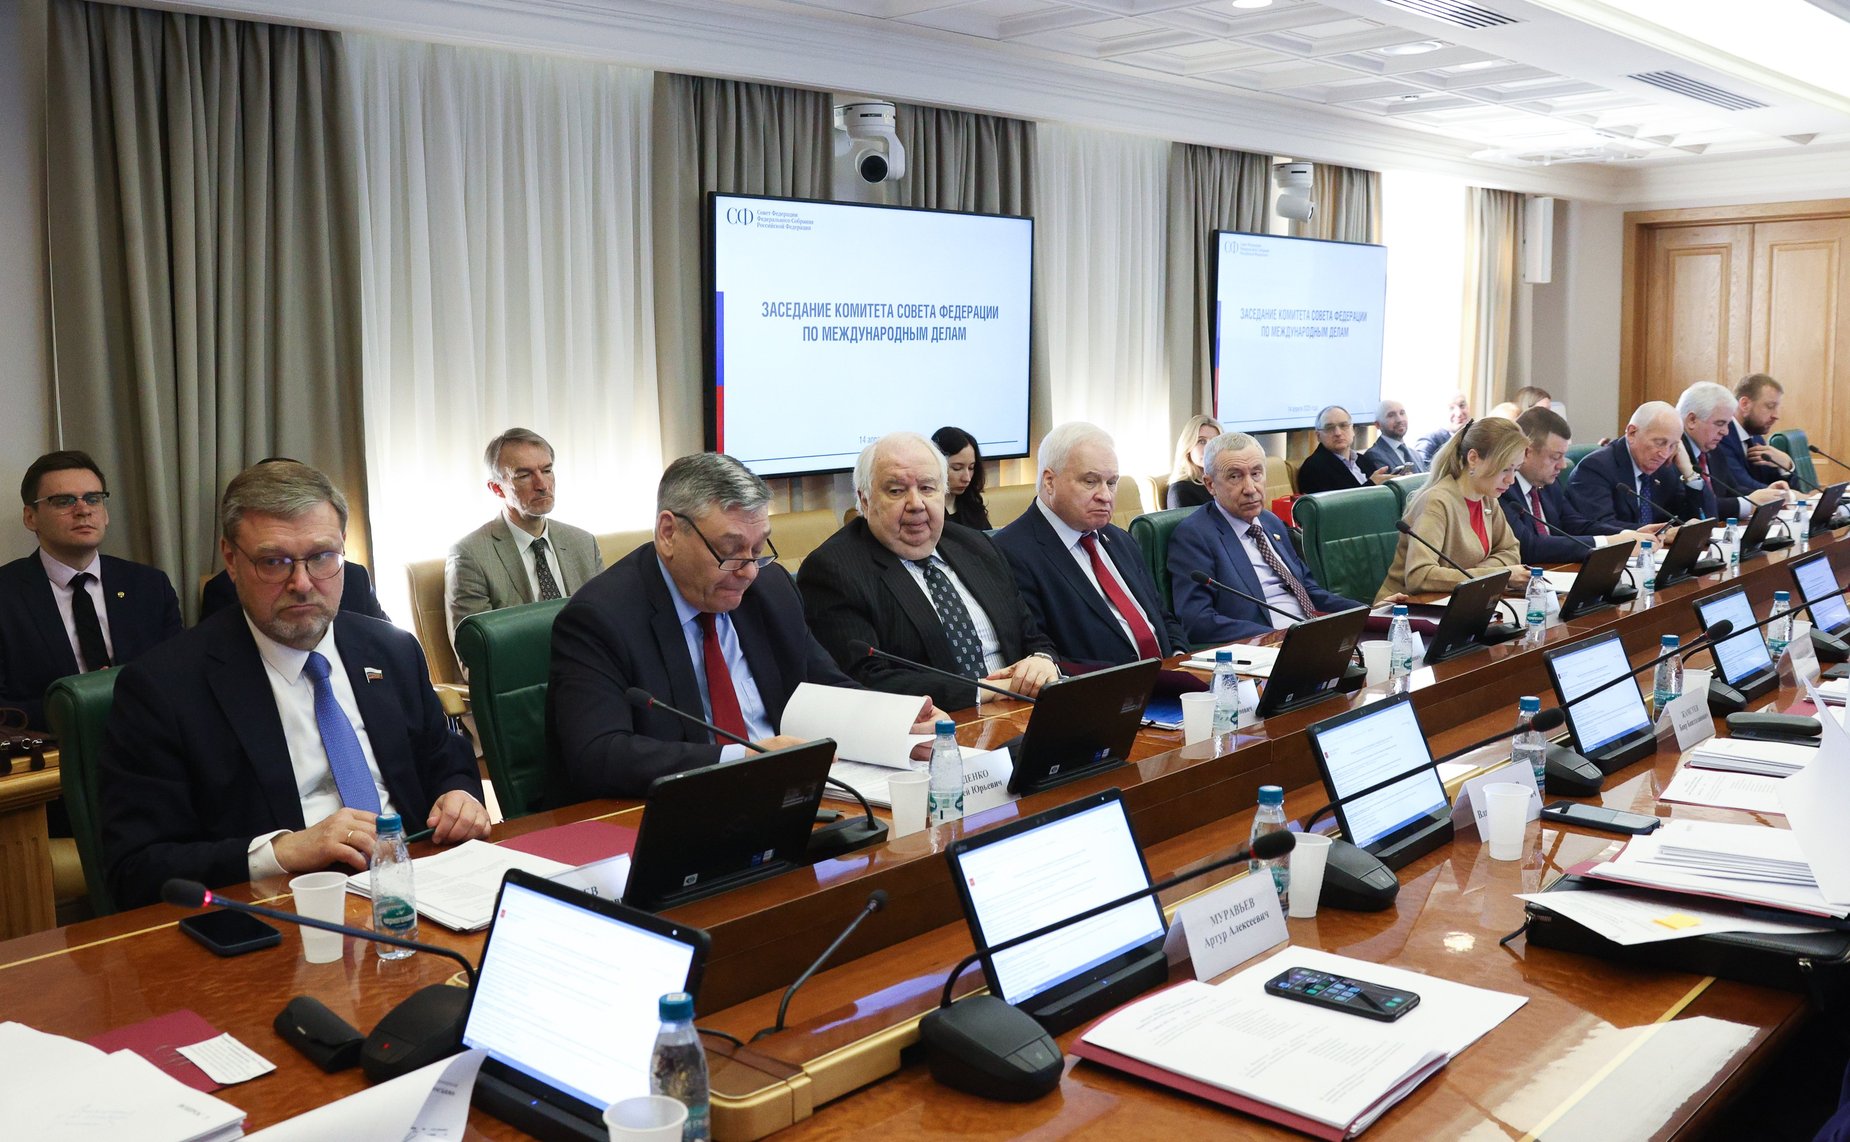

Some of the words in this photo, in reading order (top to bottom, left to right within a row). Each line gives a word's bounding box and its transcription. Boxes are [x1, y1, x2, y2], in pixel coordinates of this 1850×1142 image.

[726, 207, 754, 226] СФ
[761, 301, 832, 320] ЗАСЕДАНИЕ
[835, 302, 894, 318] КОМИТЕТА
[897, 303, 937, 319] СОВЕТА
[939, 304, 999, 321] ФЕДЕРАЦИИ
[1240, 307, 1277, 321] ЗАСЕДАНИЕ
[1279, 308, 1310, 320] КОМИТЕТА
[1311, 309, 1333, 321] СОВЕТА
[1334, 310, 1368, 322] ФЕДЕРАЦИИ
[803, 326, 819, 341] ПО
[822, 326, 929, 343] МЕЖДУНАРОДНЫМ
[931, 326, 967, 343] ДЕЛАМ
[1261, 325, 1270, 337] ПО
[1271, 326, 1329, 339] МЕЖДУНАРОДНЫМ
[1329, 326, 1350, 339] ДЕЛАМ
[963, 769, 989, 784] ДЕНКО
[971, 780, 1003, 795] Юрьевич
[1209, 897, 1256, 927] МУРАВЬЕВ
[1204, 930, 1228, 949] Артур
[1229, 910, 1270, 936] Алексеевич
